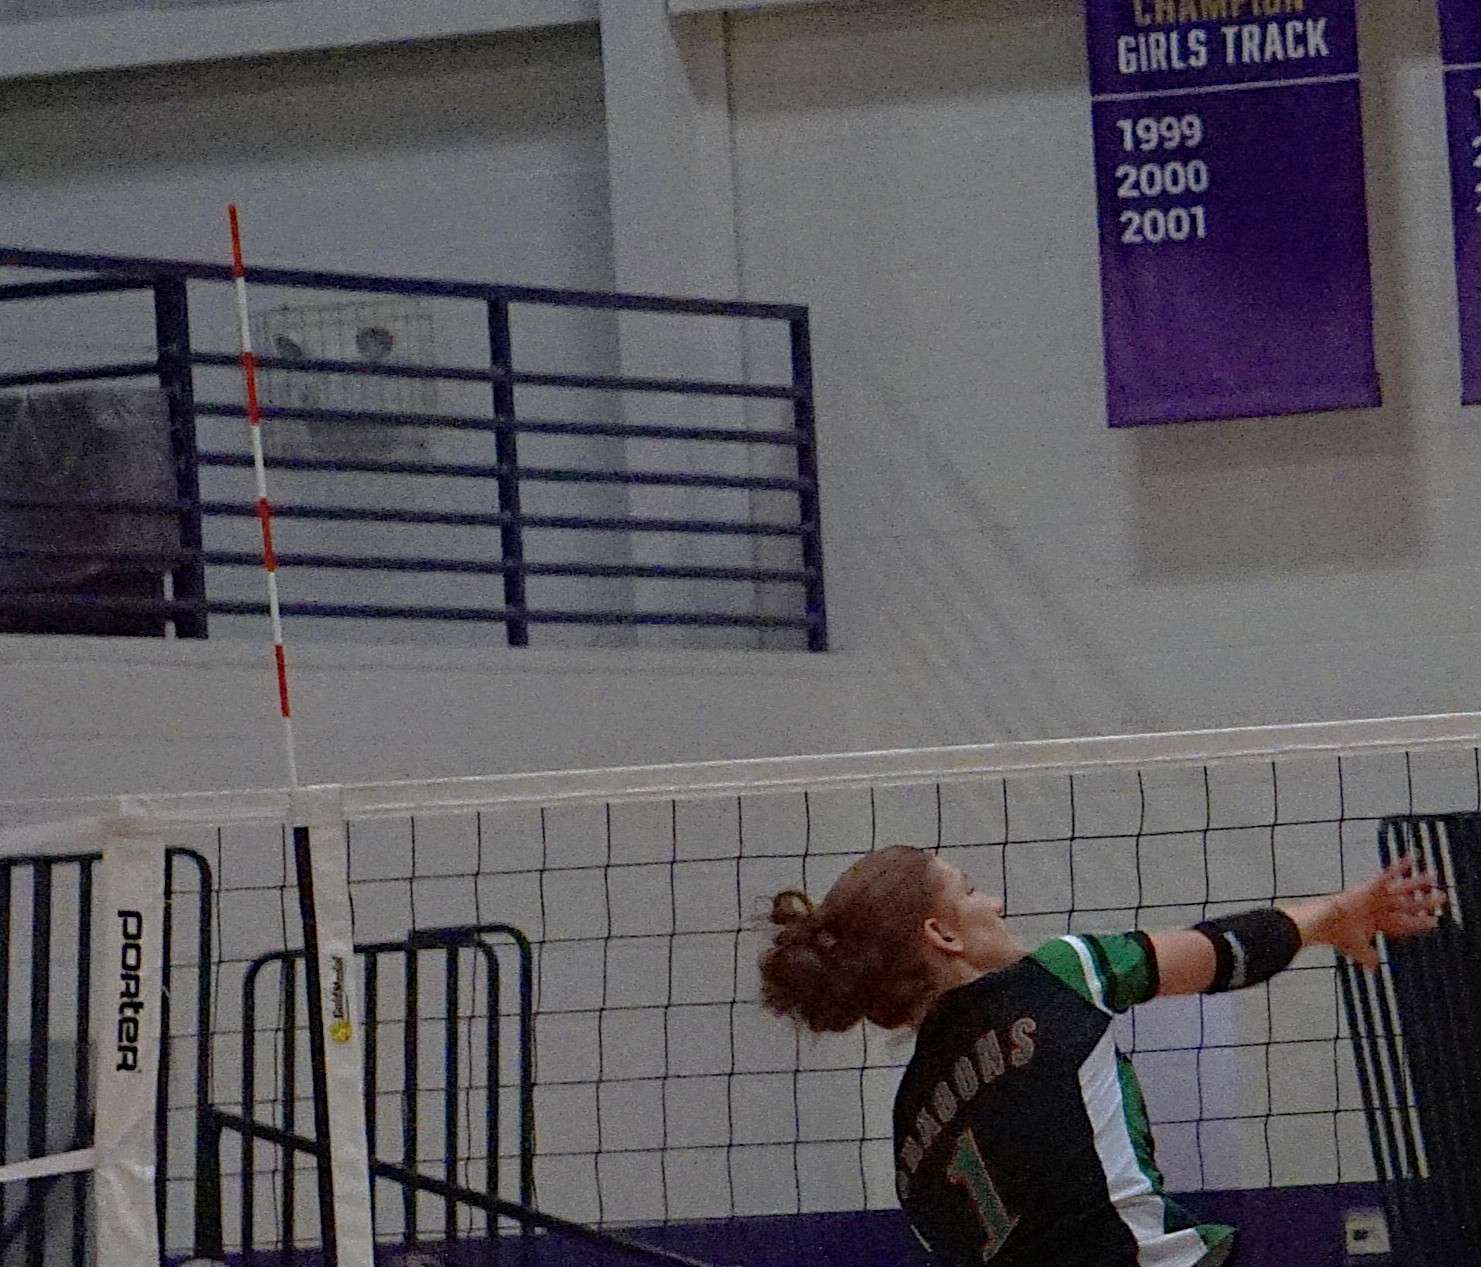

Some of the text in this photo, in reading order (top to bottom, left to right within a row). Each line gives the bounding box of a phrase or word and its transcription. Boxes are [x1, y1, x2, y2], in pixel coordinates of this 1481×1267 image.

[1117, 17, 1329, 74] GIRLS TRACK
[1116, 114, 1203, 152] 1999
[1115, 159, 1209, 198] 2000
[1119, 205, 1206, 244] 2001
[945, 1122, 1024, 1263] 1
